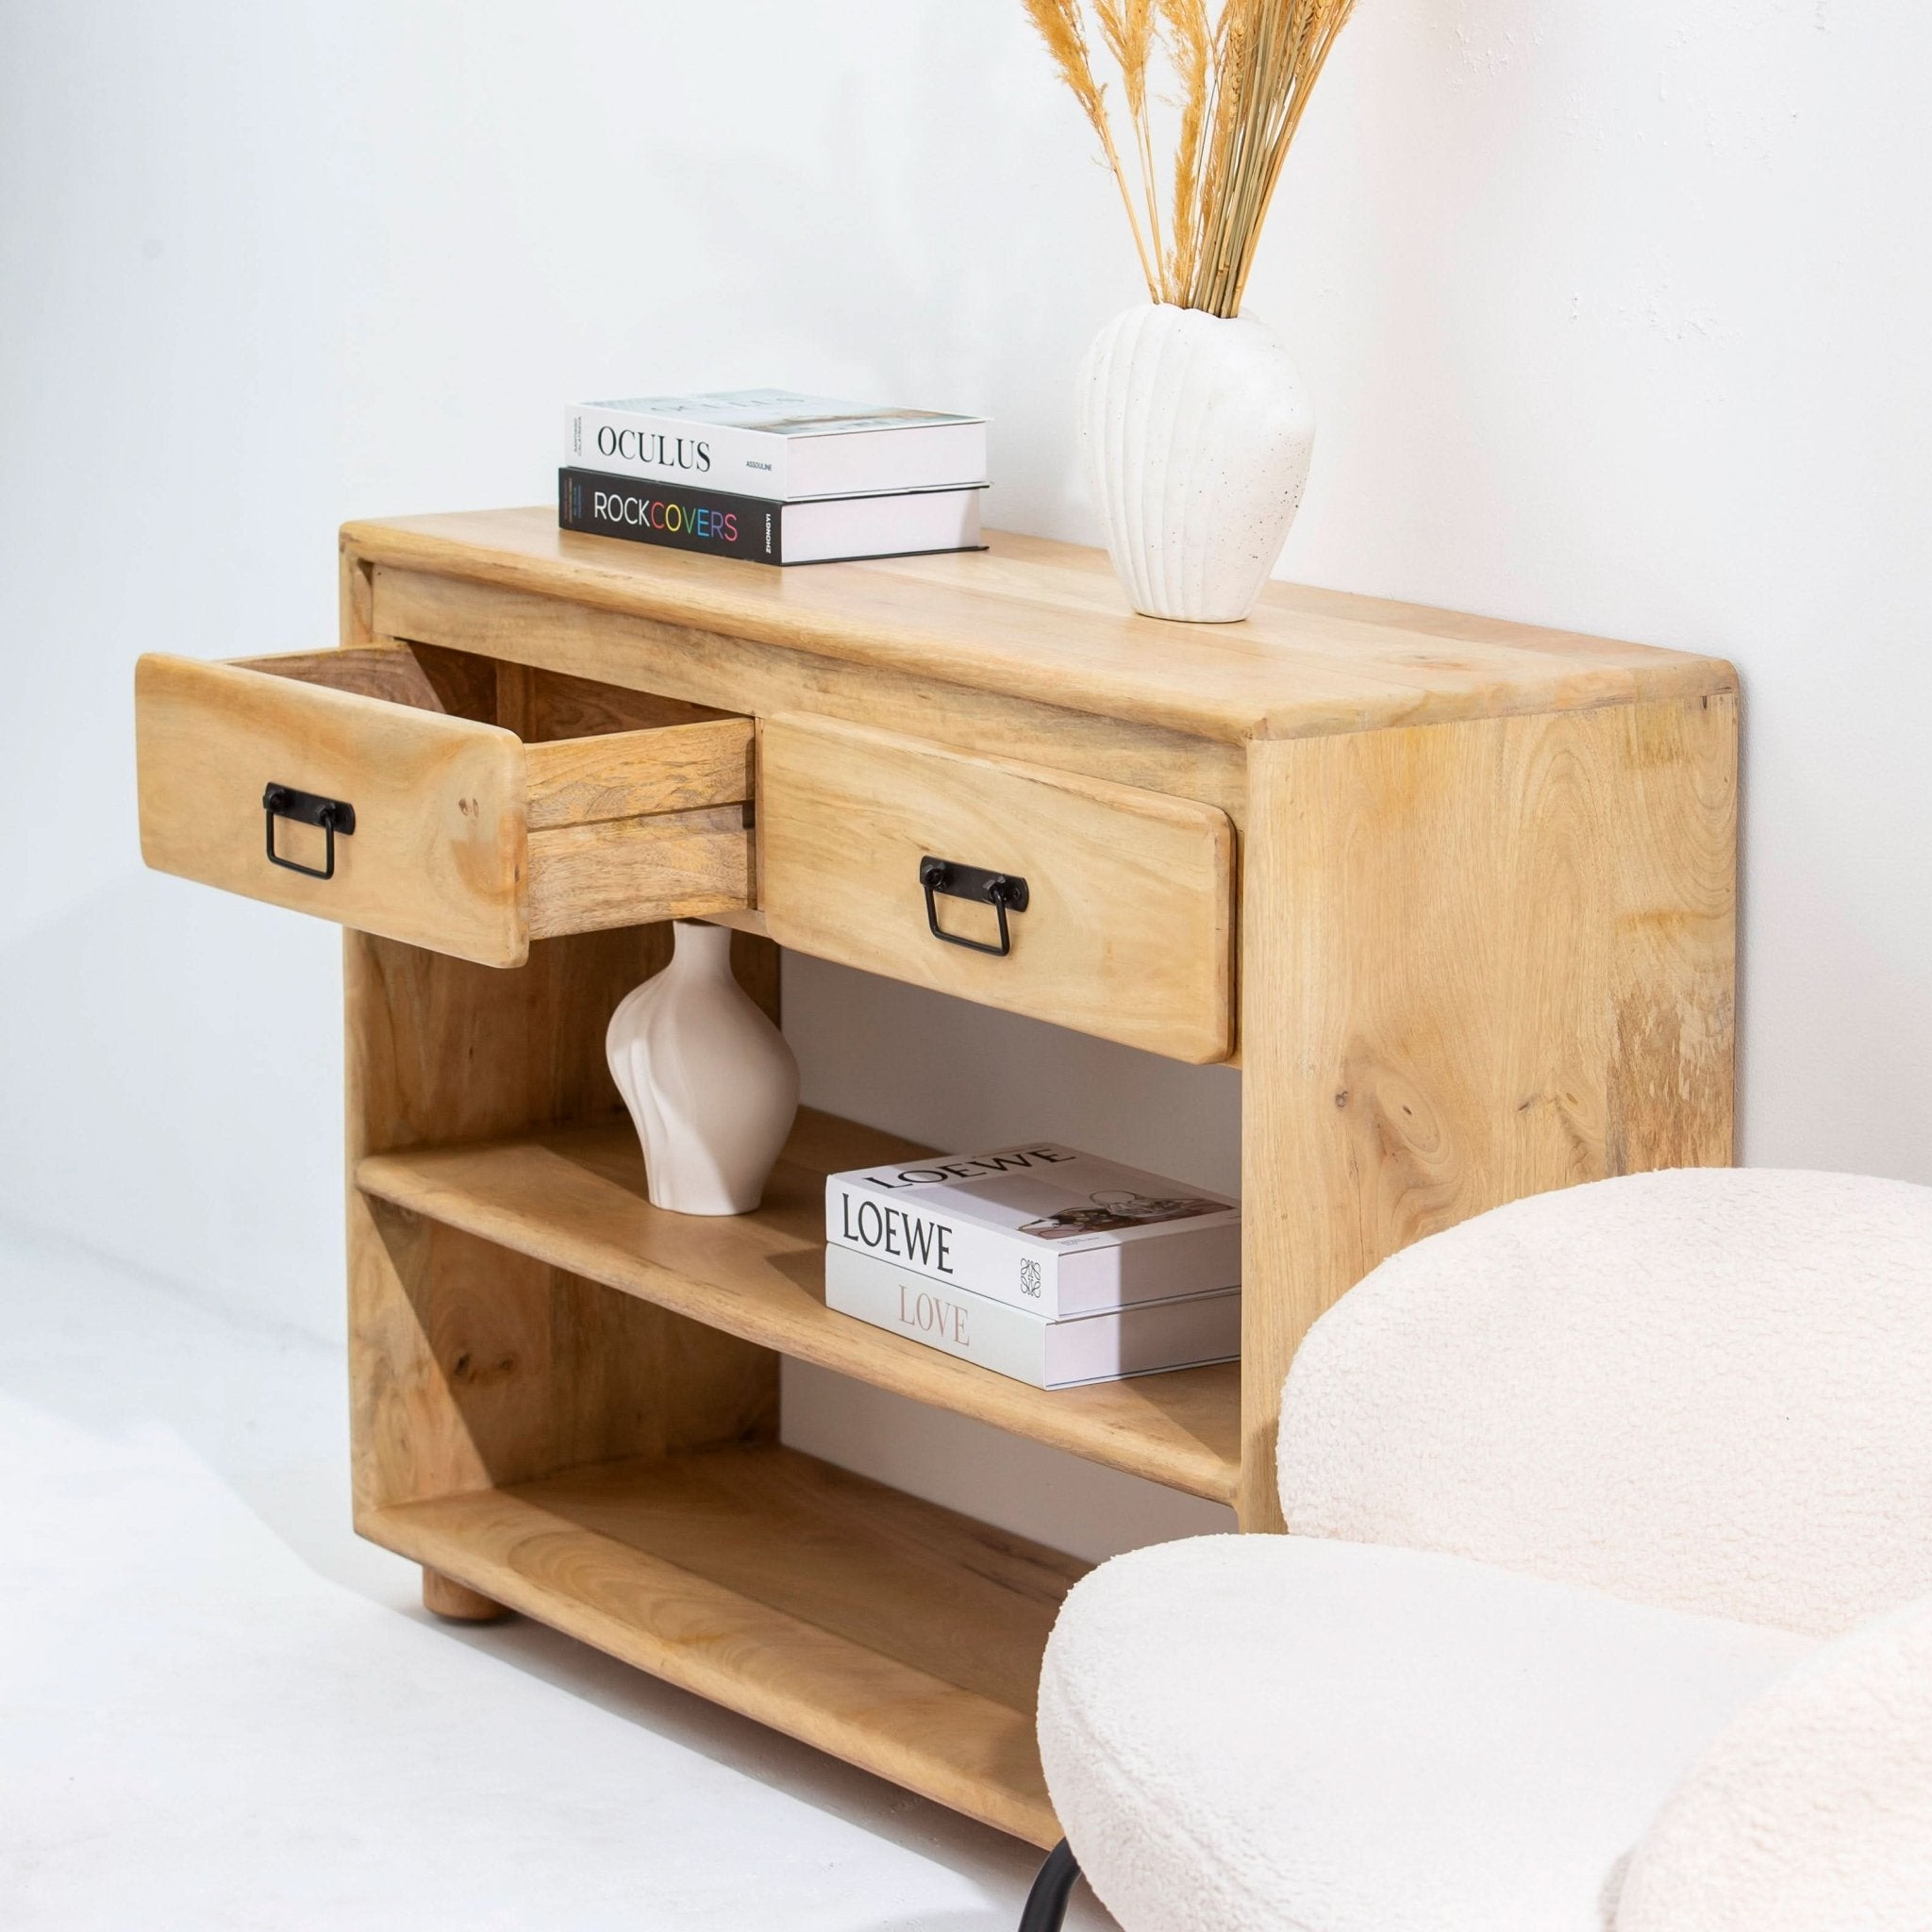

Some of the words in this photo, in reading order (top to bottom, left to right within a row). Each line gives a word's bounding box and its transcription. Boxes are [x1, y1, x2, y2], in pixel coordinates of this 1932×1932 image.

[597, 425, 711, 472] OCULUS
[745, 460, 773, 472] ASSOULINE
[593, 491, 738, 541] ROCKCOVERS
[862, 1147, 1076, 1189] LOEWE
[841, 1193, 954, 1274] LOEWE
[898, 1284, 970, 1347] LOVE
